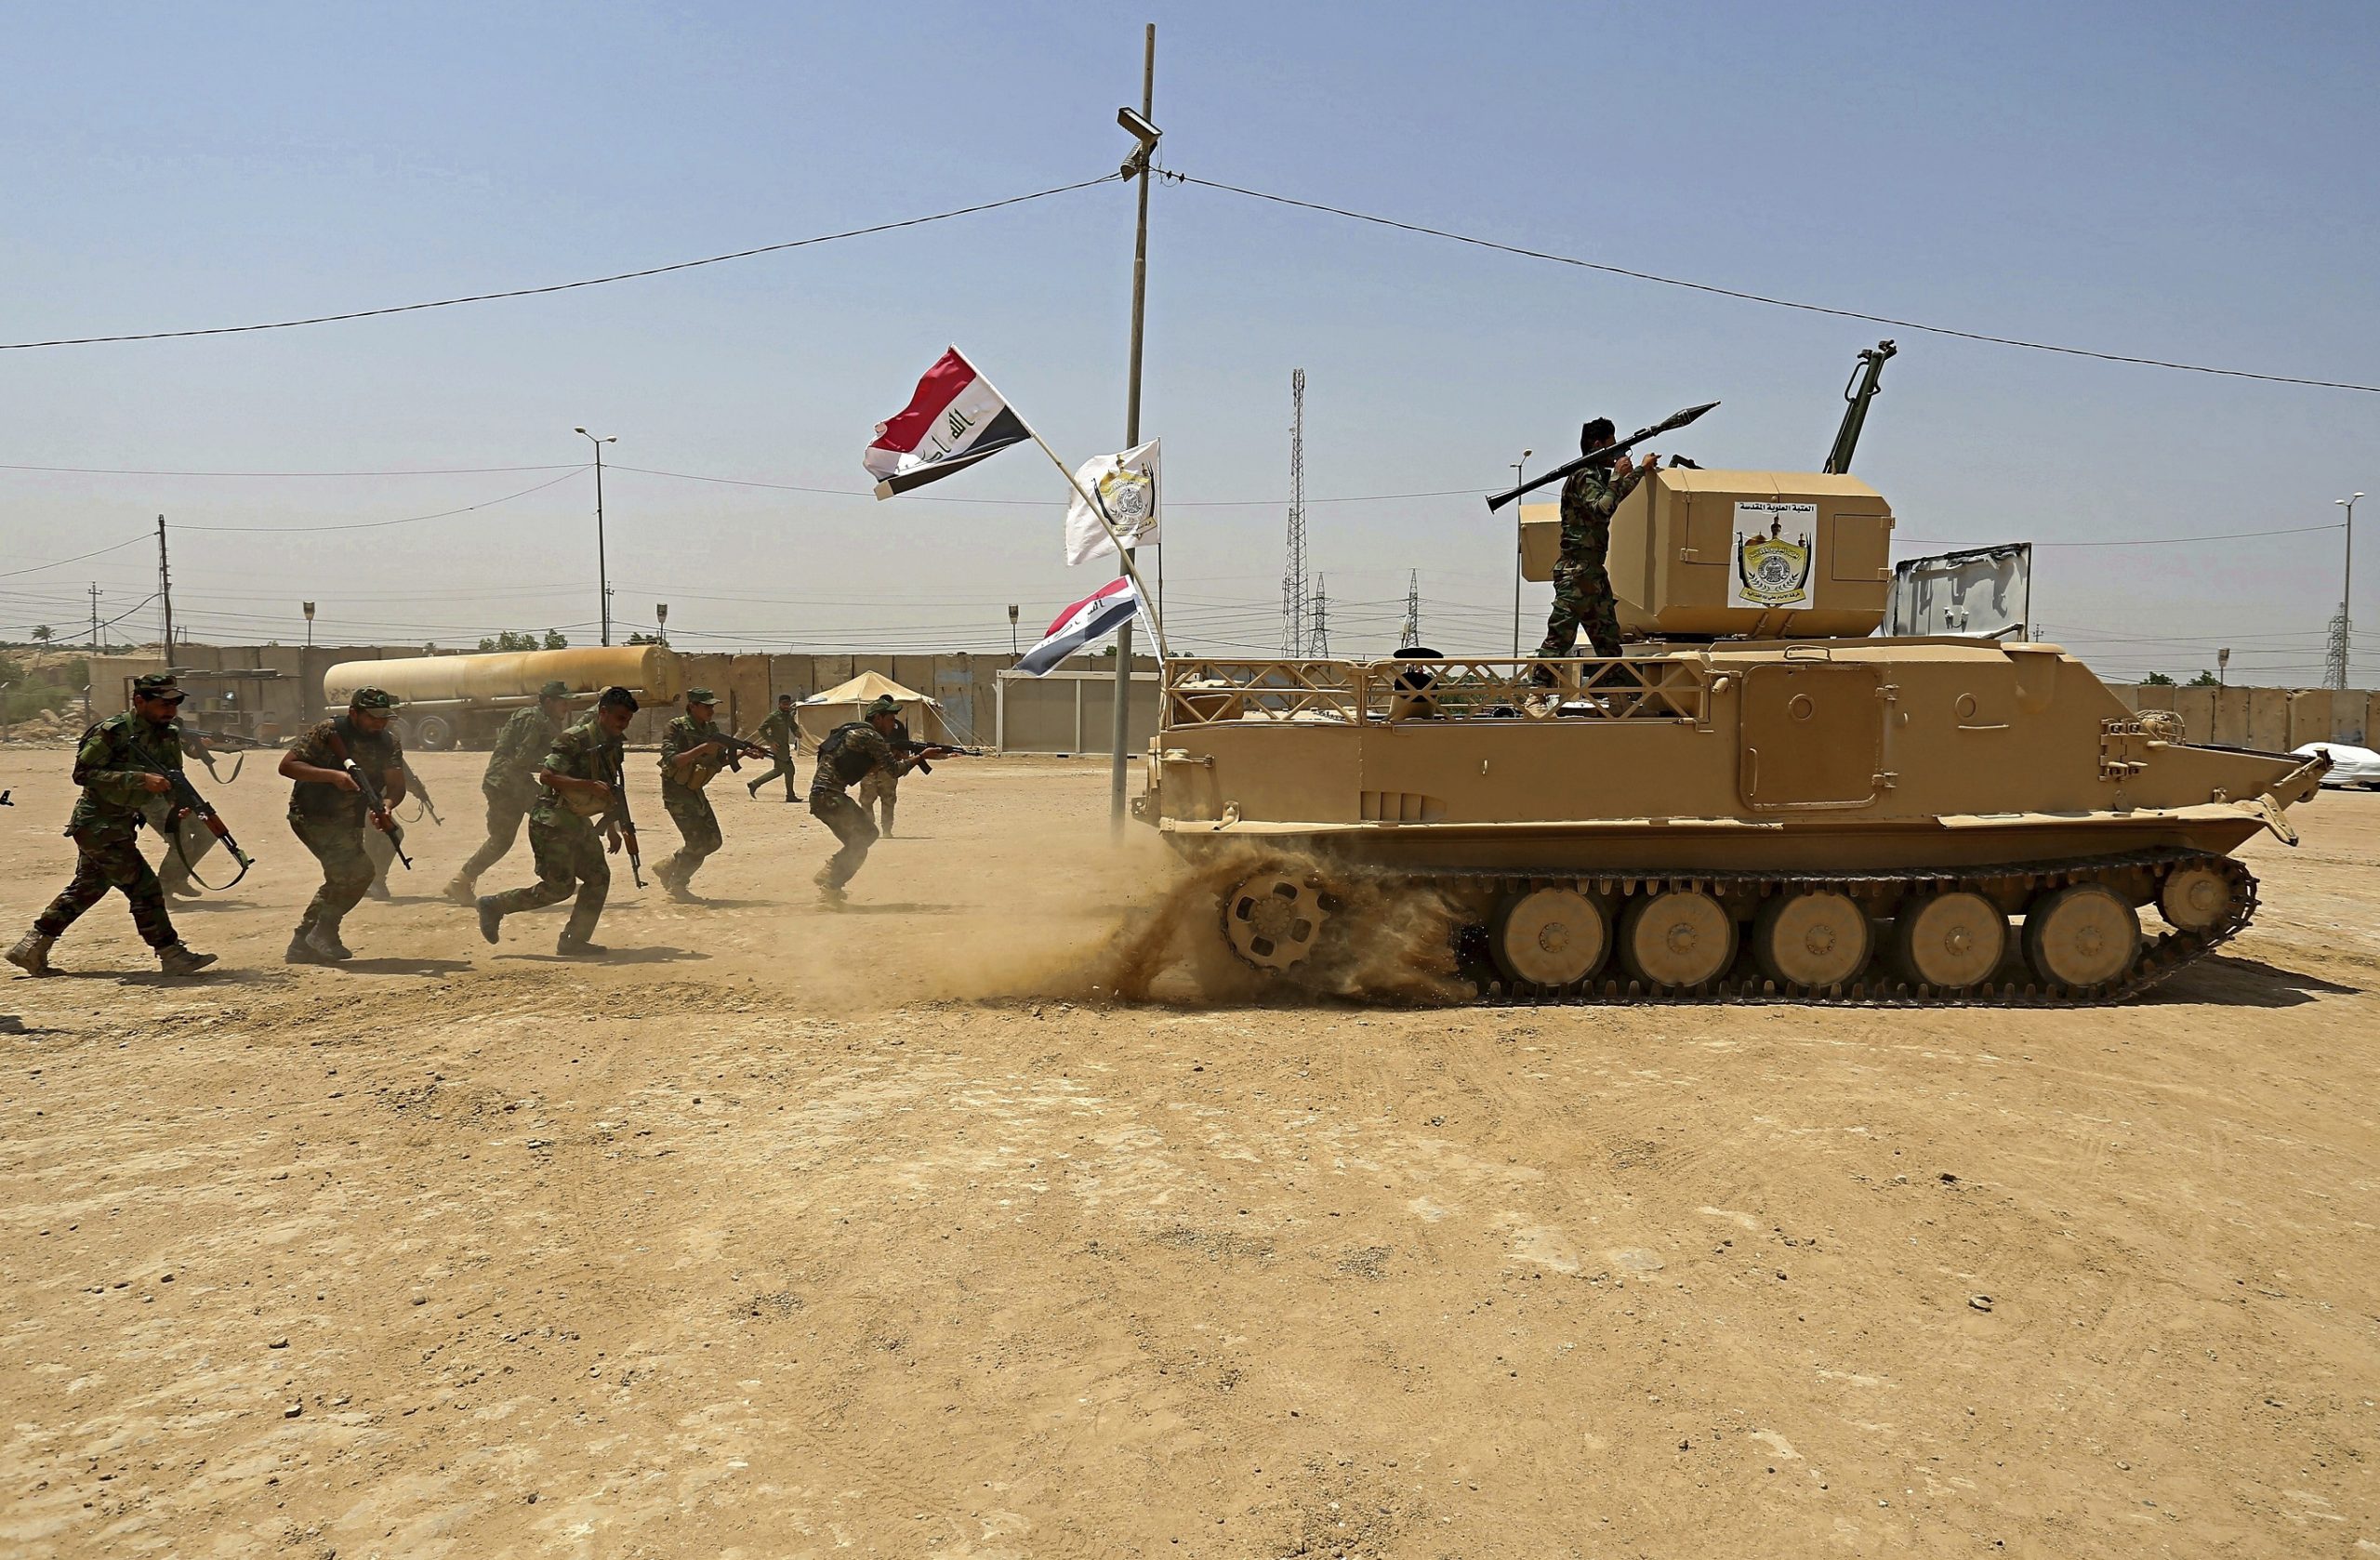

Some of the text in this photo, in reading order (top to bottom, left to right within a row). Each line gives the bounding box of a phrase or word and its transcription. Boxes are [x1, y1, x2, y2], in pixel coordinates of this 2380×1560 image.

[948, 407, 976, 440] الله
[1739, 502, 1815, 513] العتبة العلوية المقدسة
